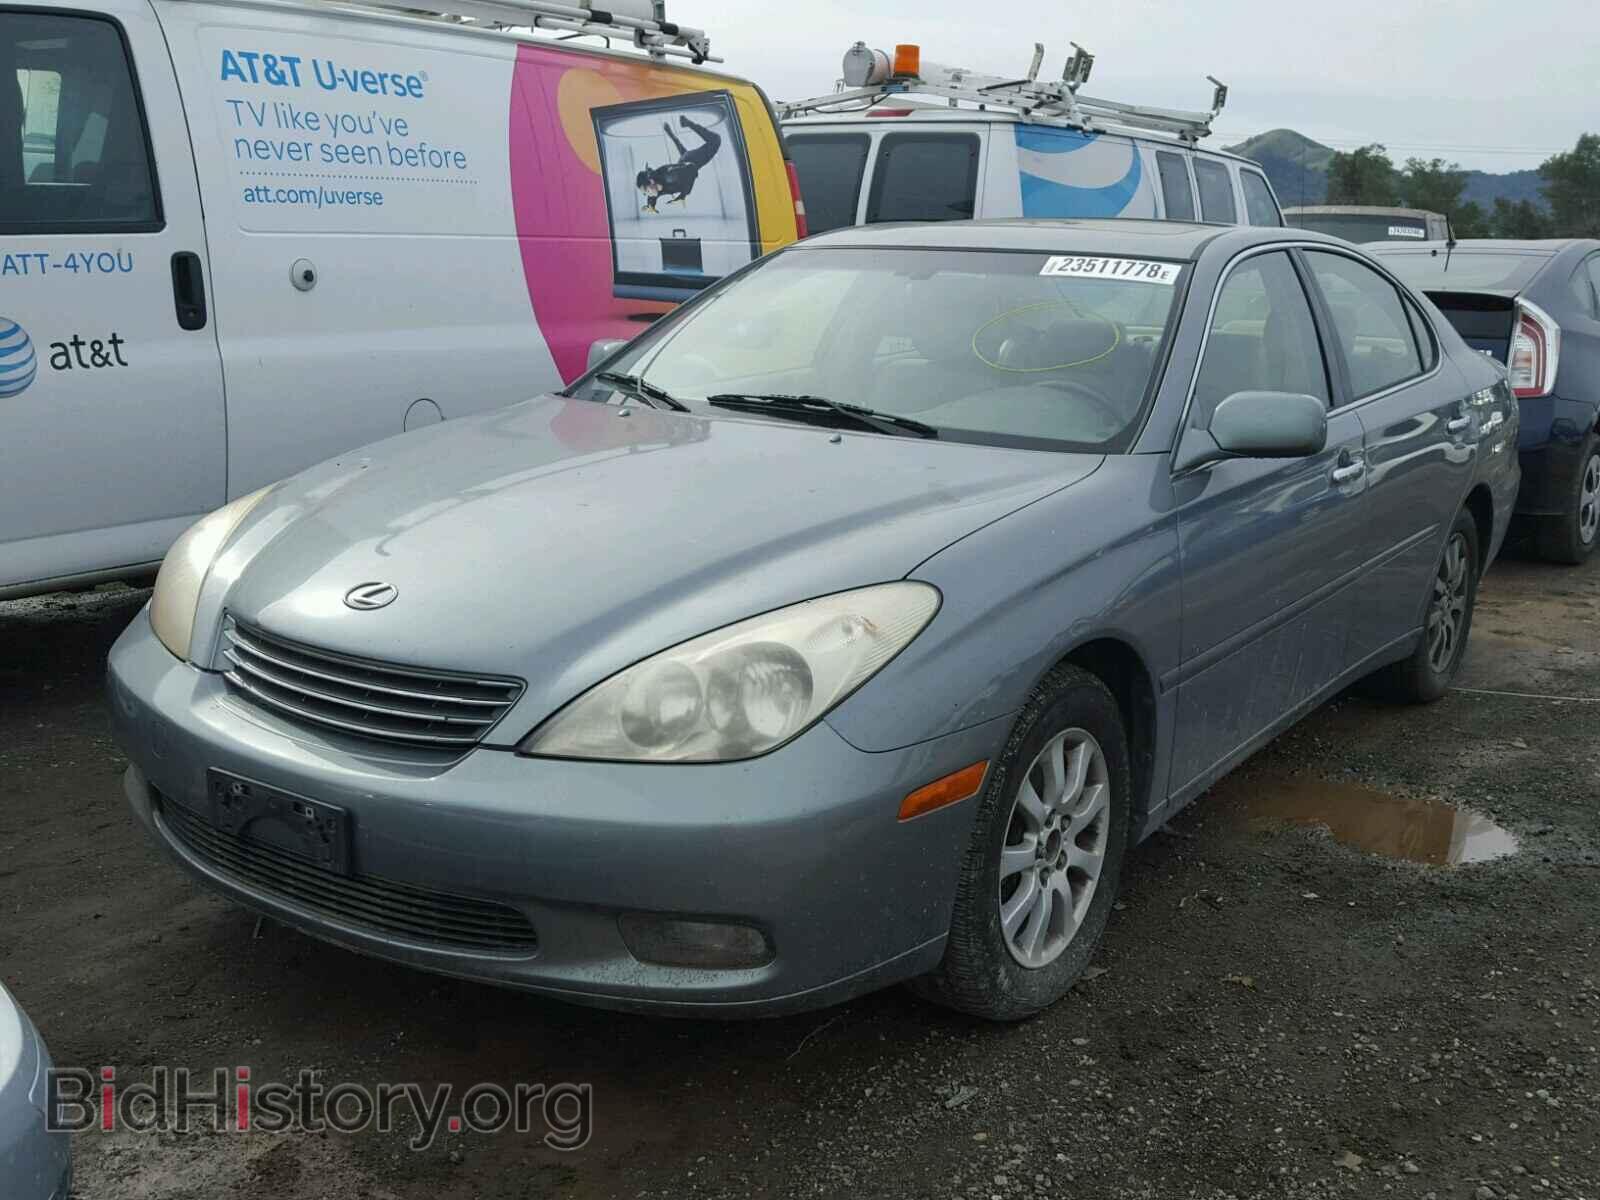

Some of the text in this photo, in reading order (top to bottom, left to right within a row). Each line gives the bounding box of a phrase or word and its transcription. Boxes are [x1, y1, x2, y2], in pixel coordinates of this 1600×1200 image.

[221, 49, 301, 88] AT&T
[226, 99, 409, 138] TV like you've
[234, 137, 468, 169] never seen before
[243, 185, 384, 209] att.com/uverse
[2, 251, 134, 276] ATT-4YOU
[49, 332, 128, 371] at&t
